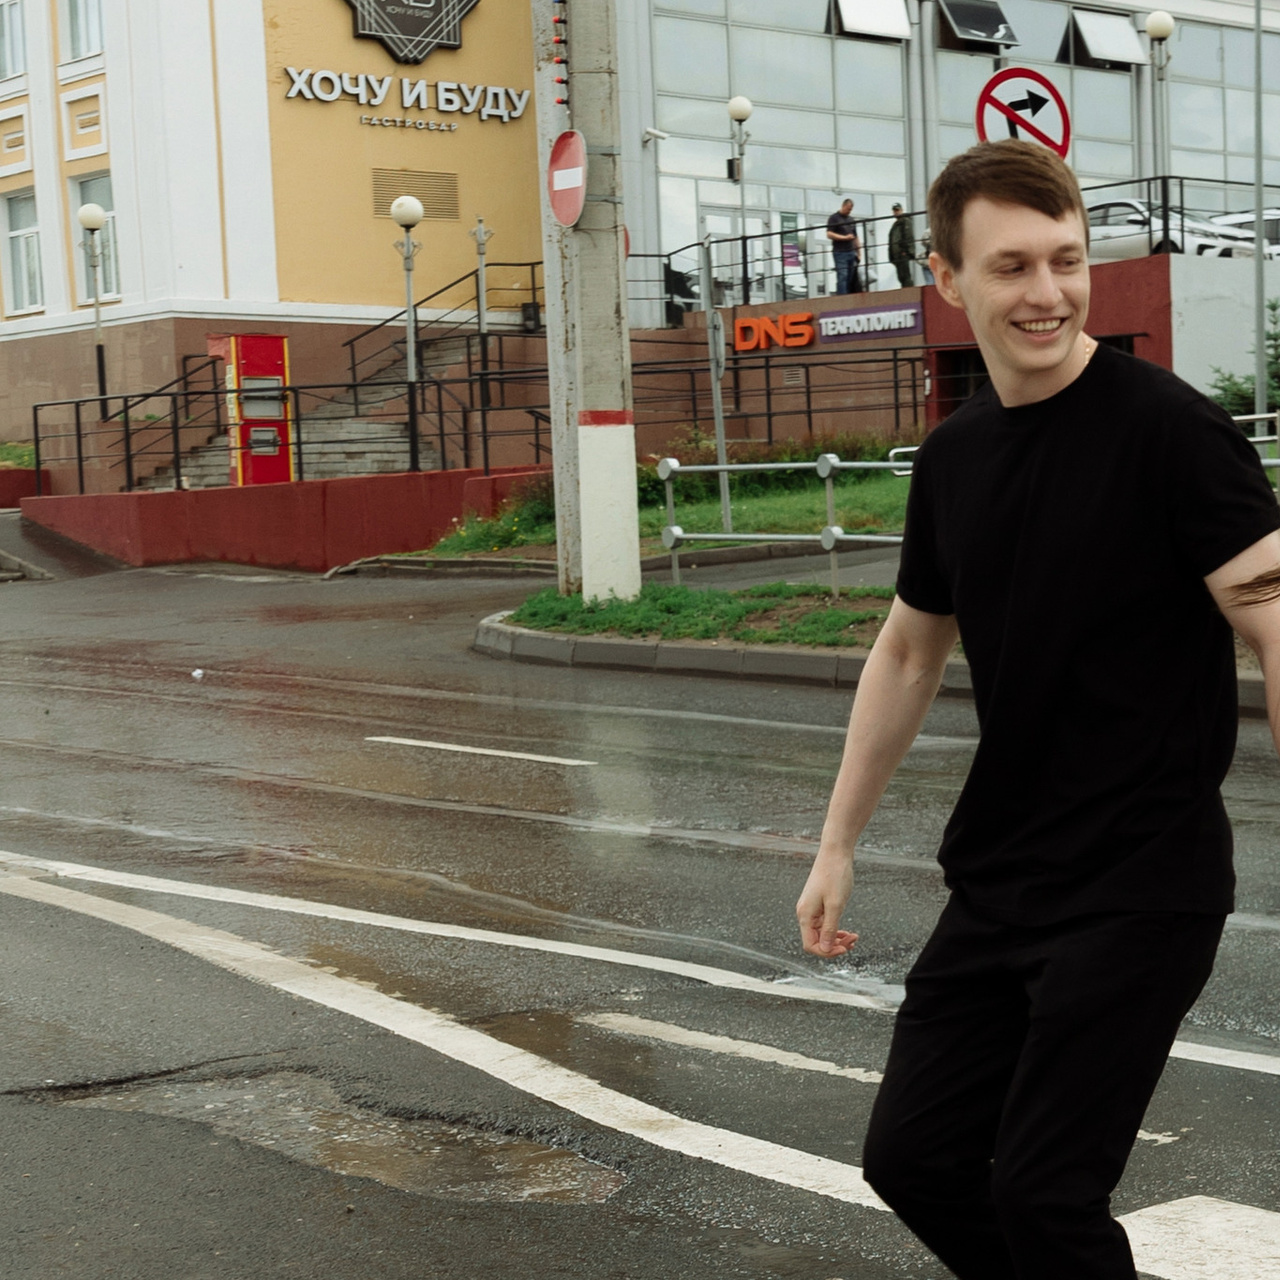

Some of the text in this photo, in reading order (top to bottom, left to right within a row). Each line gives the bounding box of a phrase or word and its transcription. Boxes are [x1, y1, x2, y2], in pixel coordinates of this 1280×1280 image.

[285, 66, 530, 123] ХОЧУ И БУДУ
[360, 114, 459, 132] ГАСТРОБАР
[734, 311, 816, 352] DNS
